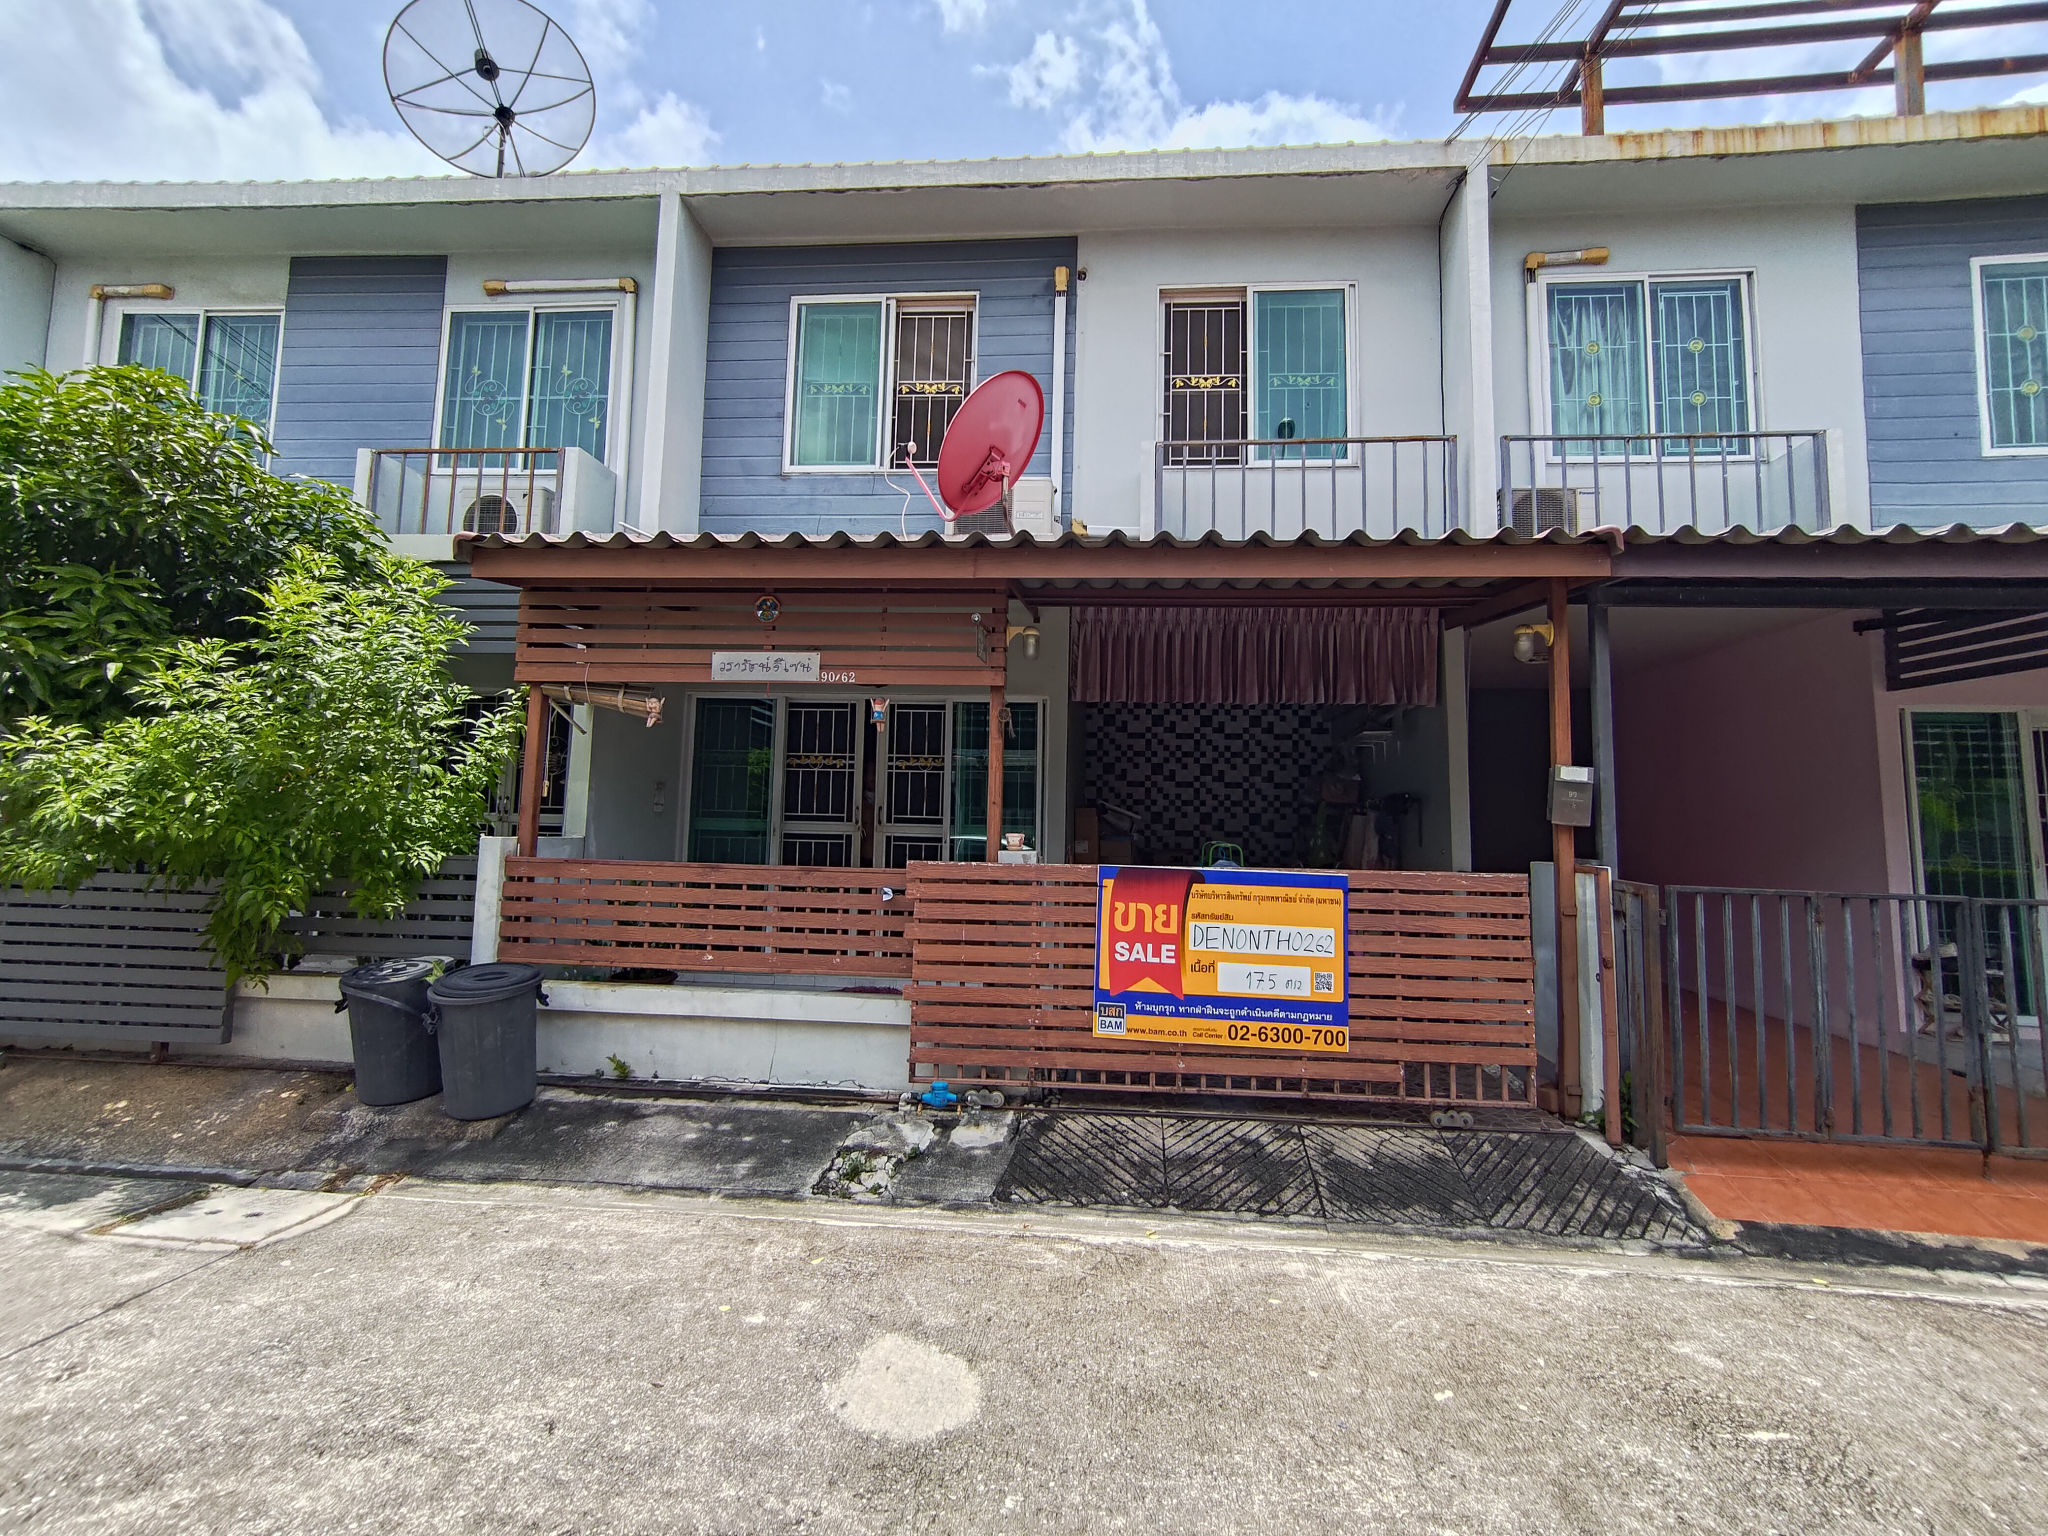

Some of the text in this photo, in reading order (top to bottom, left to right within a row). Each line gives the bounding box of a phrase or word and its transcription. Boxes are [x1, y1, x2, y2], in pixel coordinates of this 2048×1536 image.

[821, 671, 856, 683] 90/62
[1114, 902, 1178, 934] ขาย
[1114, 941, 1176, 964] SALE
[1190, 959, 1216, 974] เนื้อที่
[1100, 1006, 1123, 1017] บสก
[1134, 1001, 1176, 1015] ห้ามบุกรุก
[1100, 1019, 1122, 1030] BAM
[1126, 1027, 1188, 1037] www.bam.co.th
[1227, 1024, 1346, 1047] 02-6300-700
